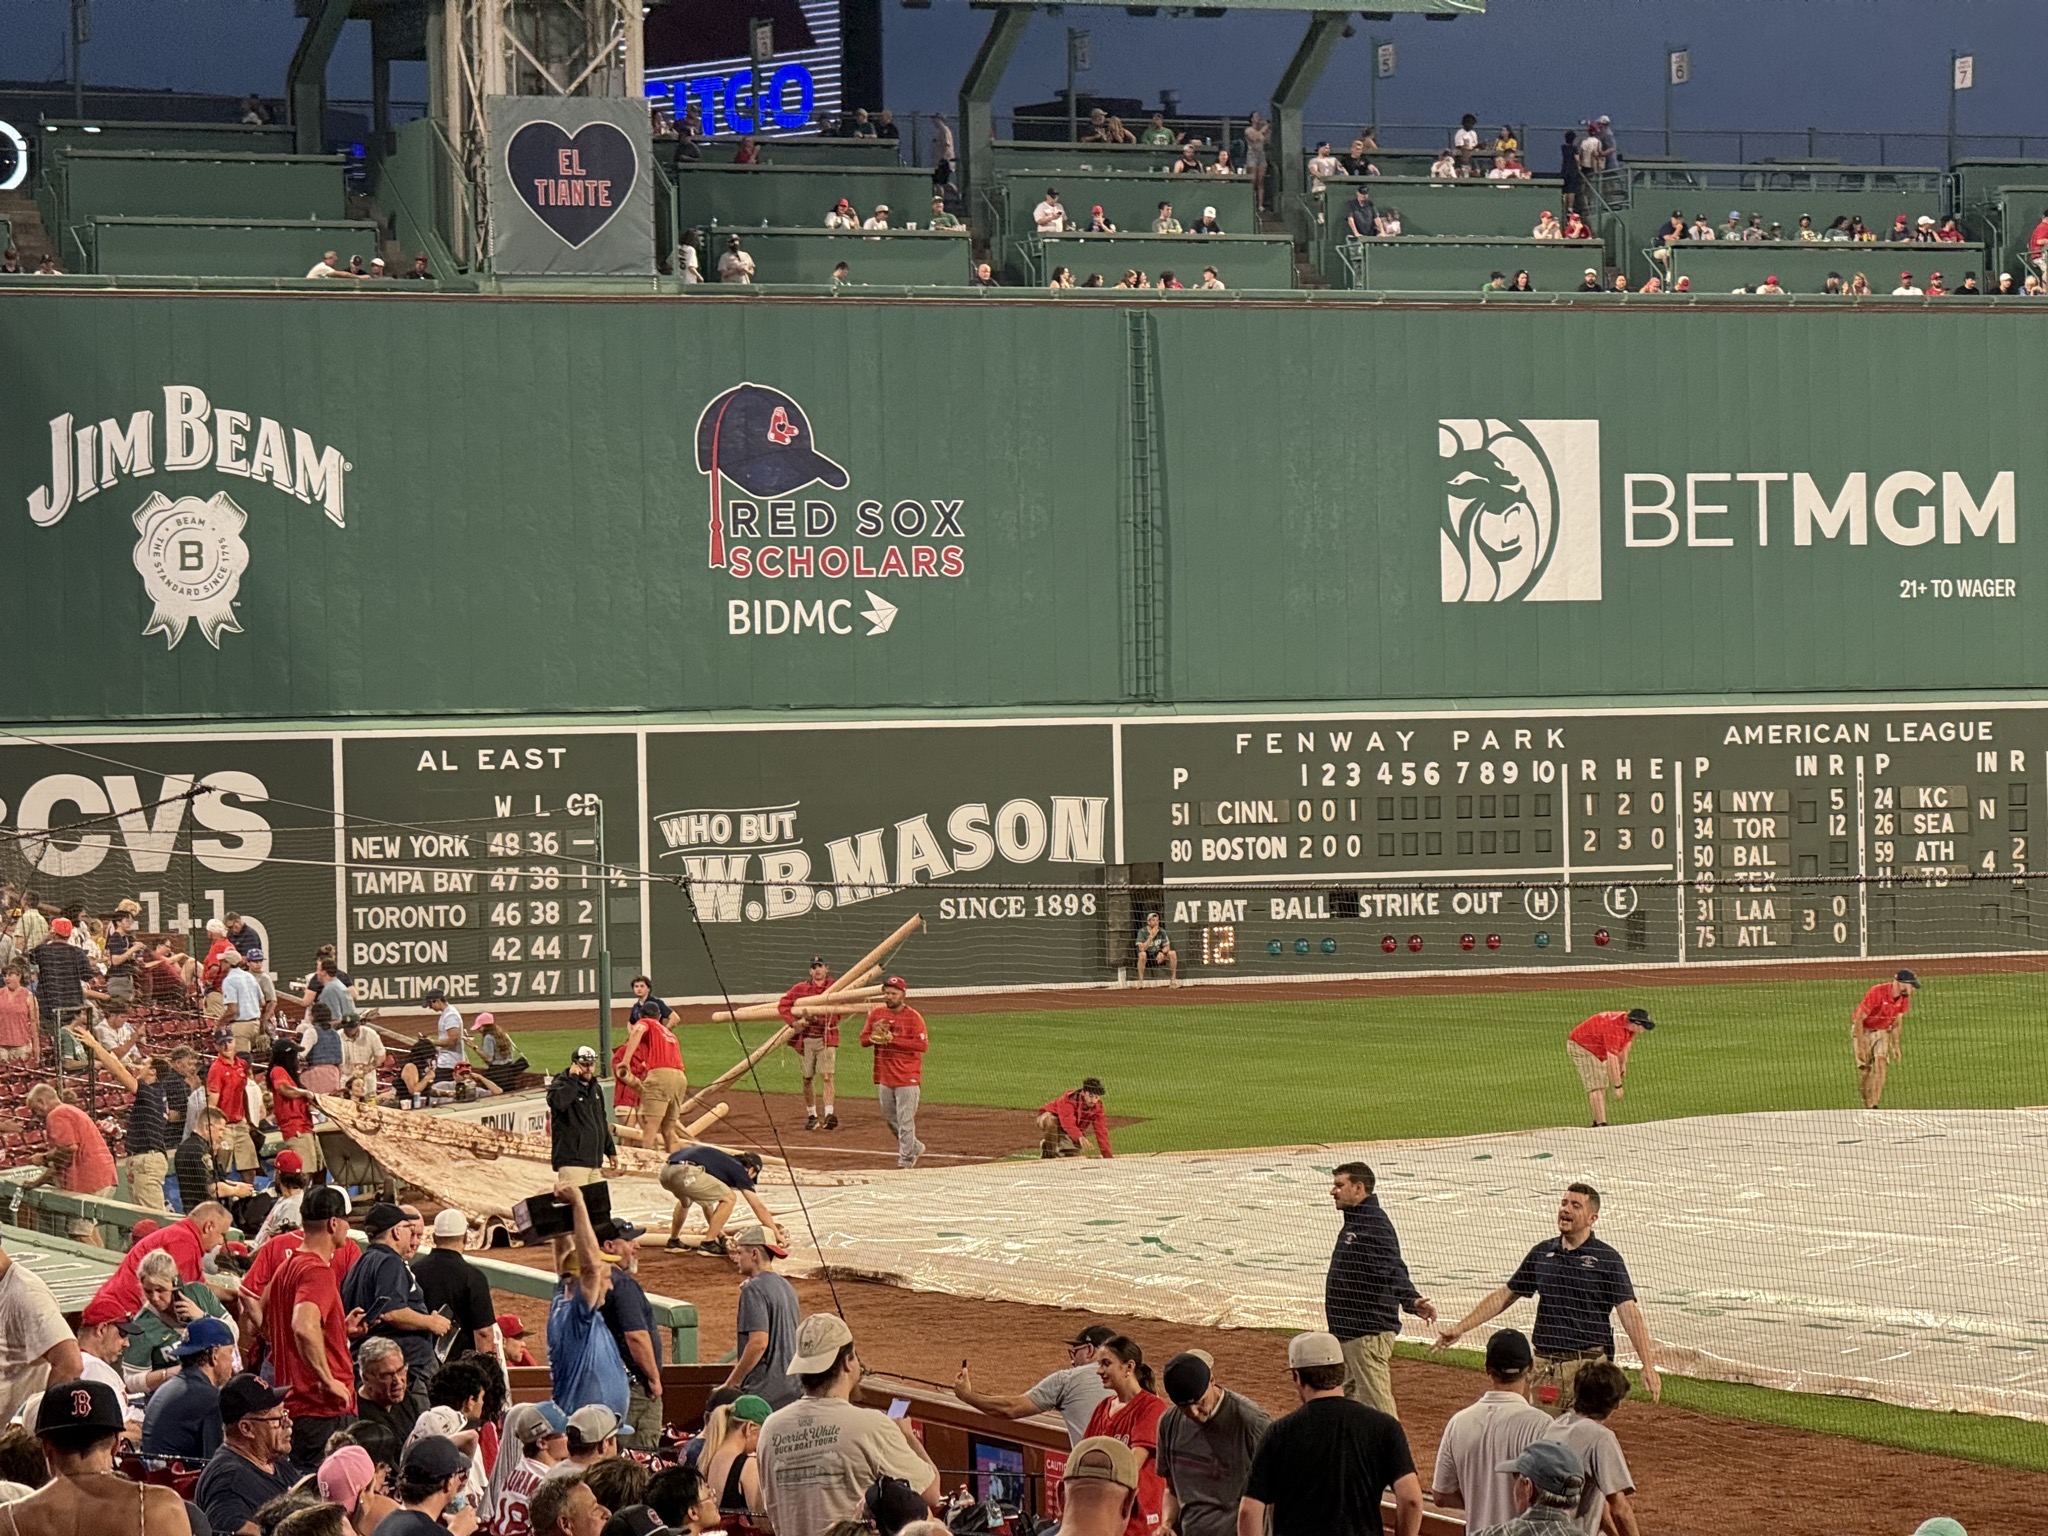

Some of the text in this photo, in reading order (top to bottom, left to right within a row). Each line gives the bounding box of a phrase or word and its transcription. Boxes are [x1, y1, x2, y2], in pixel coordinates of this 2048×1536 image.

[1676, 65, 1684, 79] 6
[1960, 71, 1968, 85] 7
[558, 148, 587, 176] EL
[534, 179, 612, 207] TIANTE
[27, 409, 155, 527] JIM
[176, 516, 206, 527] BEAM
[729, 500, 965, 537] RED SOX
[1623, 470, 2016, 547] BETMGM
[153, 537, 231, 596] THE STANDARD SINCE 1795
[179, 541, 204, 571] B
[729, 545, 965, 578] SCHOLARS
[1900, 579, 2016, 598] 21+ TO WAGER
[728, 599, 852, 635] BIDMC
[1237, 728, 1564, 754] FENWAY PARK
[1724, 722, 1992, 744] AMERICAN LEAGUE
[417, 748, 566, 771] AL EAST
[1696, 750, 2025, 778] P IN R P IN R
[1174, 759, 1663, 789] P 1 2 3 4 5 6 7 8 9 10 R H E
[495, 796, 511, 817] W
[536, 795, 550, 816] L
[1172, 793, 1663, 825] 51 CINN. 0 0 1 1 2 0
[1694, 787, 1948, 813] 54 NYY 5 24 KC
[1980, 799, 1994, 819] N
[17, 770, 273, 877] CVS
[659, 811, 797, 848] WHO BUT
[1694, 813, 1954, 839] 34 TOR 12 26 SEA
[352, 832, 559, 859] NEW YORK 48 36
[1171, 828, 1663, 862] 80 BOSTON 2 0 0 2 3 0
[1694, 838, 2024, 867] 50 BAL 59 ATH 2
[1982, 851, 1995, 872] 4
[352, 872, 425, 894] TAMPA
[433, 871, 474, 893] BAY
[490, 867, 519, 891] 47
[529, 866, 560, 890] 38
[581, 864, 588, 889] 1
[1734, 872, 1777, 892] TEX
[352, 900, 593, 930] TORONTO 46 38 2
[939, 893, 1097, 920] SINCE 1898
[1173, 887, 1630, 923] AT BAT BALL STRIKE OUT H E
[1697, 896, 1846, 920] 31 LAA 0
[1803, 910, 1815, 931] 3
[1203, 926, 1235, 965] 12
[1696, 922, 1847, 948] 75 ATL 0
[353, 935, 593, 965] BOSTON 42 44 7
[354, 970, 596, 1000] BALTIMORE 37 47 11
[71, 1390, 91, 1417] B
[774, 1436, 837, 1455] DUCK BOAT TOURS
[809, 1425, 840, 1439] White
